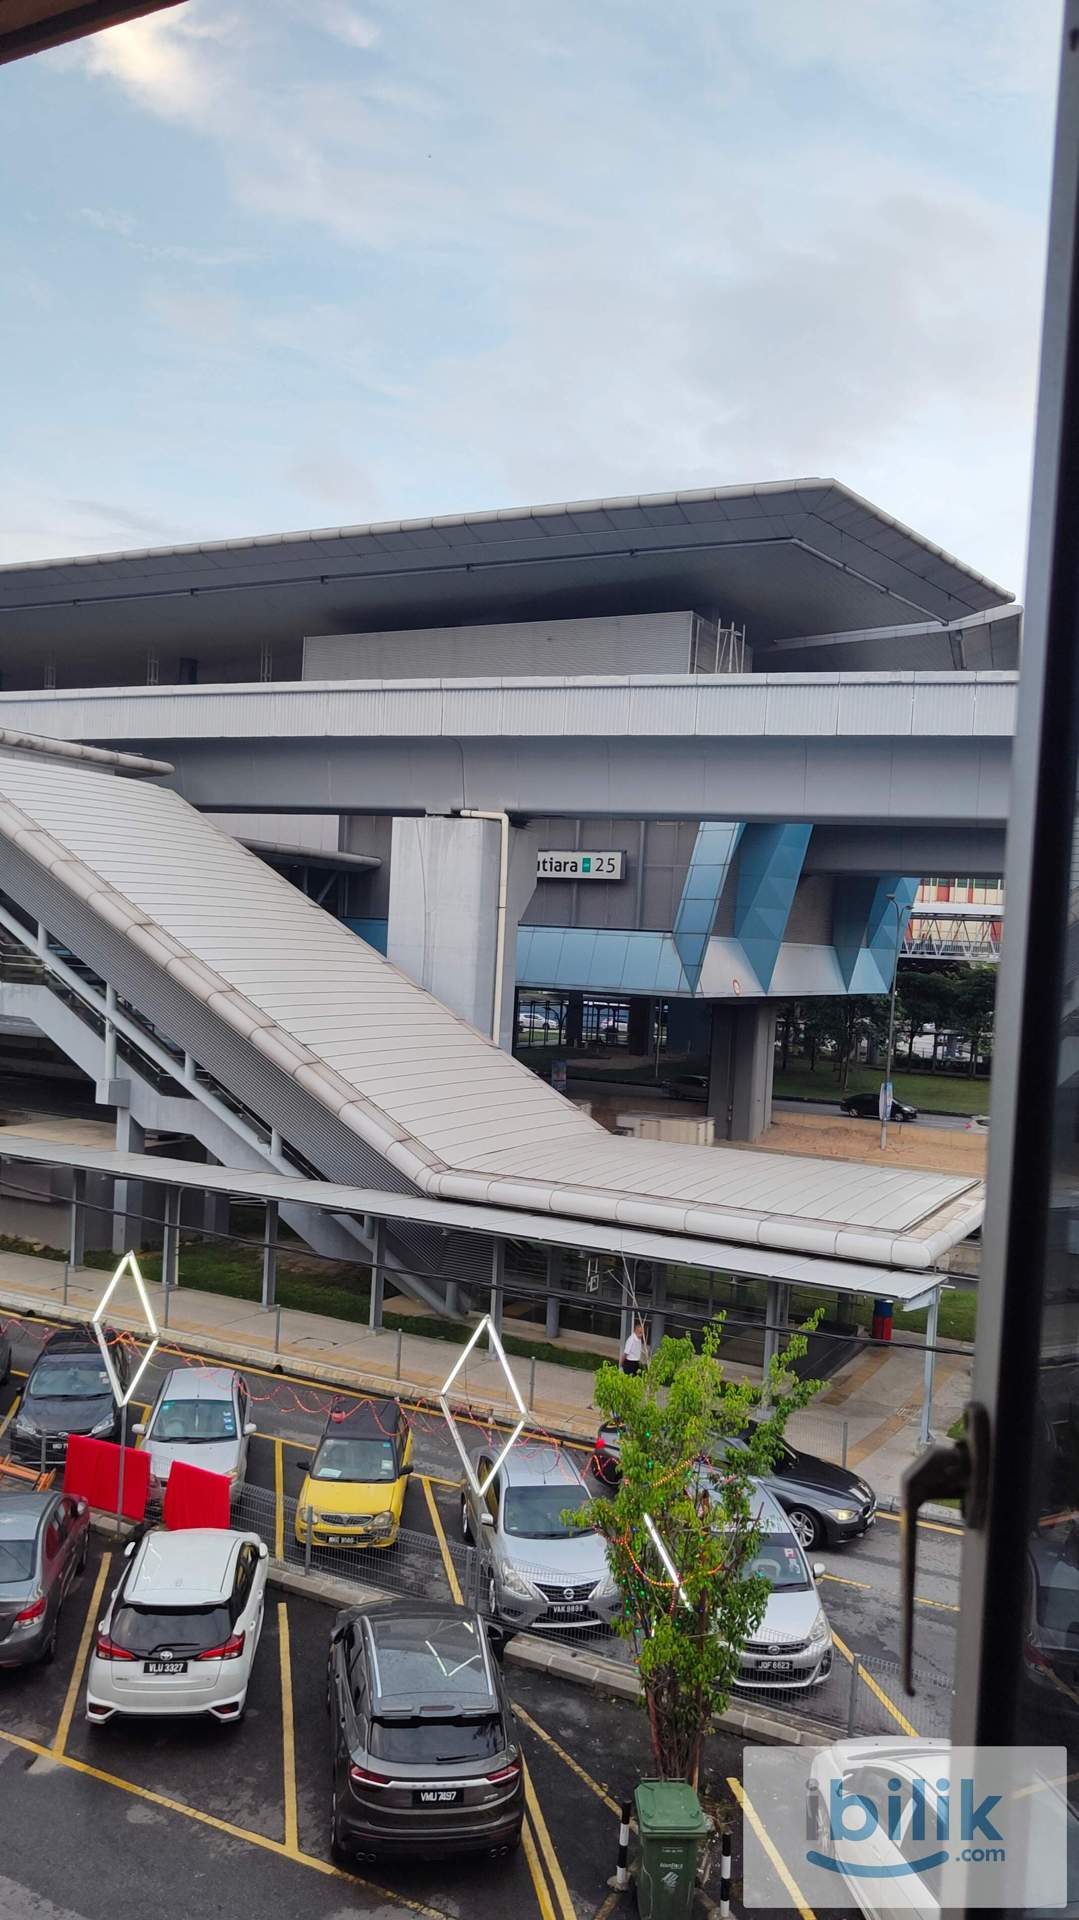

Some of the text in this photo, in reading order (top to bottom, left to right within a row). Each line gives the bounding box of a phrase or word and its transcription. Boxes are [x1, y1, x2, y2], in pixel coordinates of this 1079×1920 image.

[595, 857, 616, 873] 25
[149, 1663, 184, 1672] VLU 3327
[420, 1791, 437, 1802] VMU
